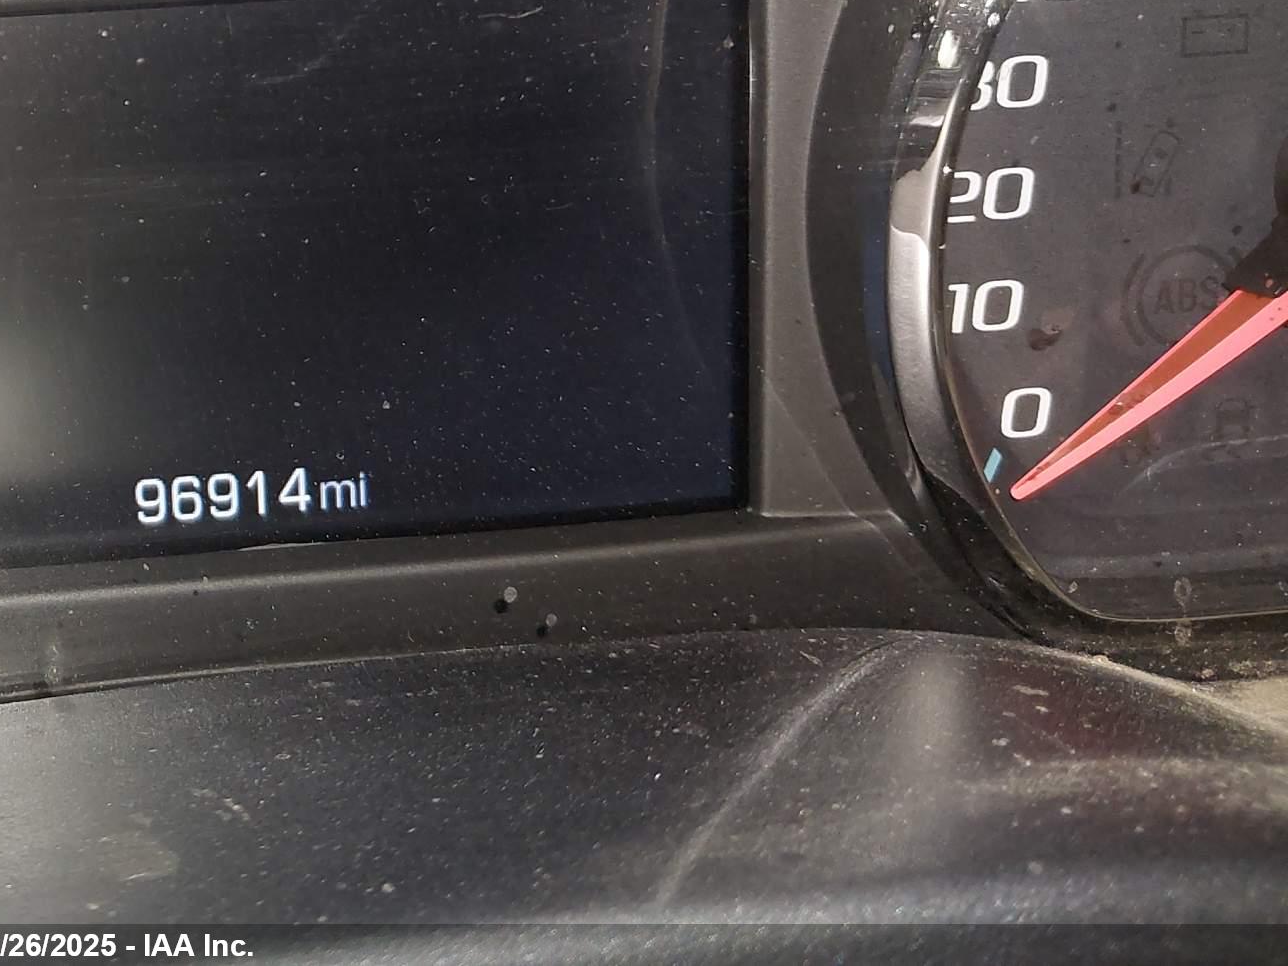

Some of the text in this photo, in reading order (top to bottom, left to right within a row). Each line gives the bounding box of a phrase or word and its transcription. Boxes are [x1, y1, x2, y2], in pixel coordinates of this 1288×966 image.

[947, 167, 1035, 223] 20
[949, 279, 1024, 334] 10
[1001, 387, 1052, 438] 0
[135, 468, 368, 524] 96914 mi
